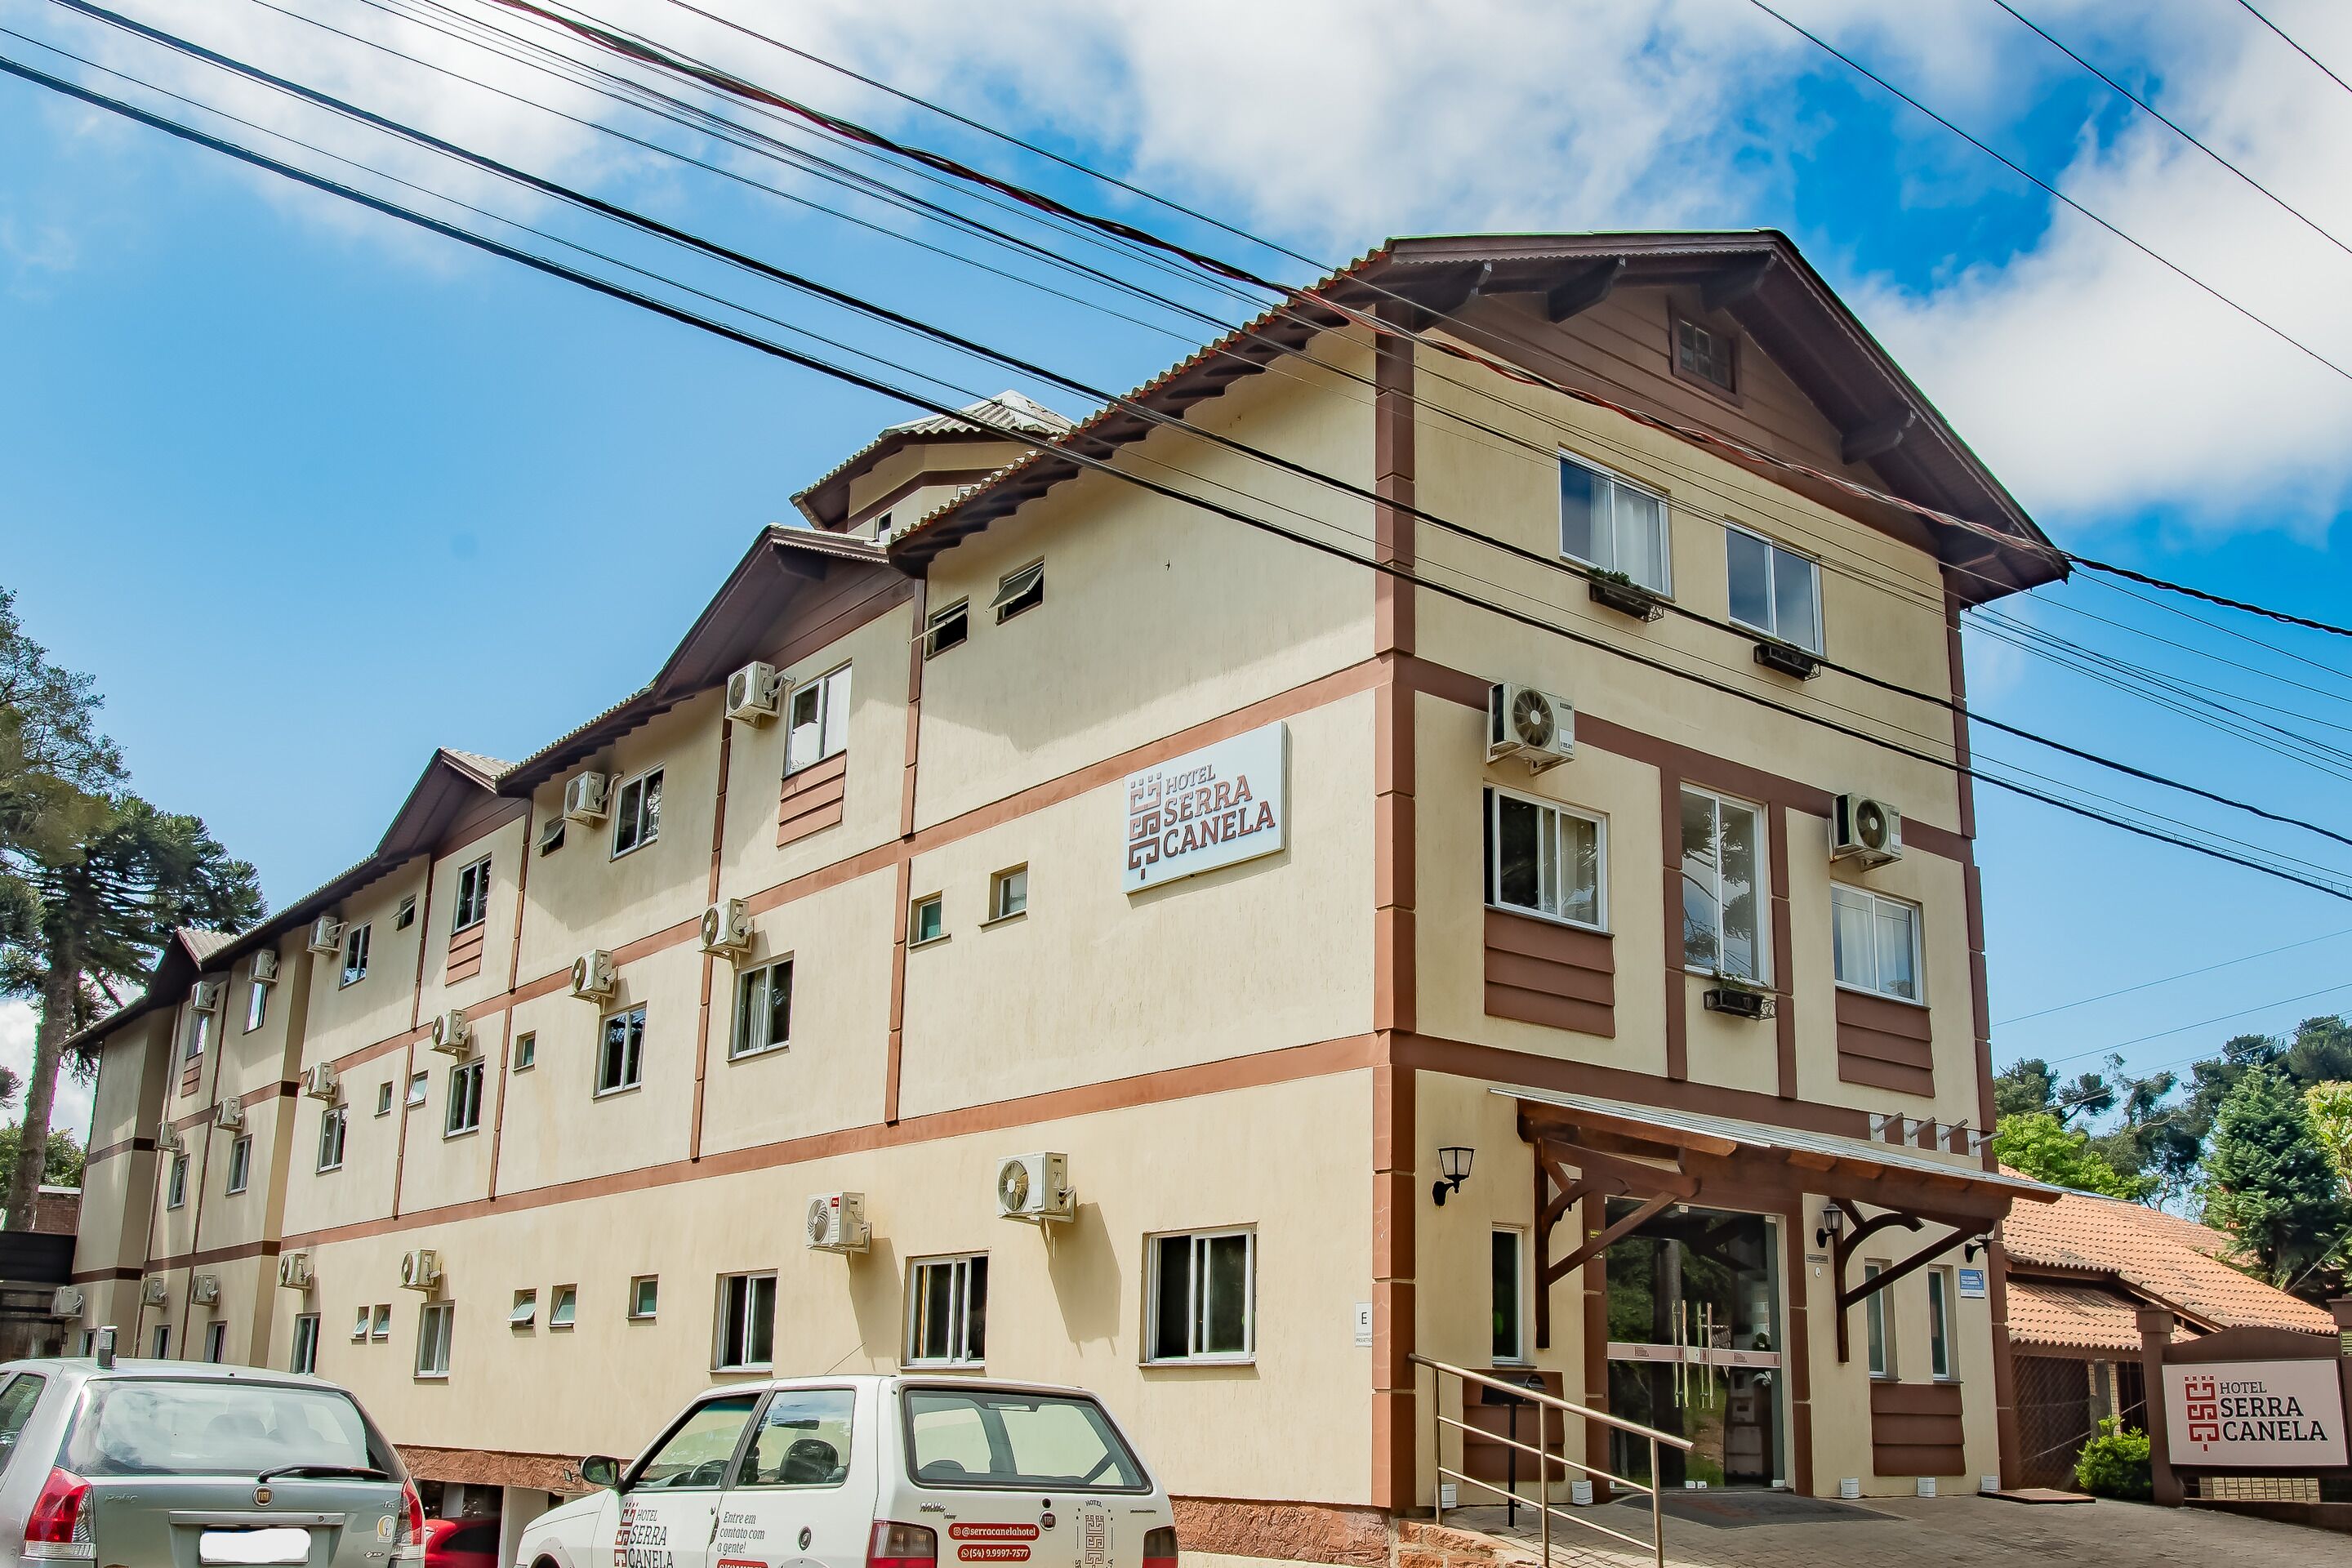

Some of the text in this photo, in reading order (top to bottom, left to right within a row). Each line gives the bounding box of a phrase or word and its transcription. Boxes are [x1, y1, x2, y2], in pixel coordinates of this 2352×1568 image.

[1165, 764, 1216, 795] HOTEL
[1164, 775, 1253, 826] SERRA
[1163, 800, 1276, 858] CANELA
[1361, 1312, 1367, 1325] E
[2220, 1382, 2267, 1394] HOTEL
[2220, 1396, 2304, 1418] SERRA
[2222, 1420, 2328, 1441] CANELA
[1085, 1499, 1102, 1508] HOTEL
[636, 1509, 657, 1521] HOTEL
[724, 1512, 756, 1525] Entre em
[630, 1525, 667, 1546] SERRA
[719, 1527, 765, 1539] contato com
[962, 1527, 1036, 1537] @serracanelahotel
[717, 1541, 746, 1556] a gente!
[628, 1548, 674, 1568] CANELA
